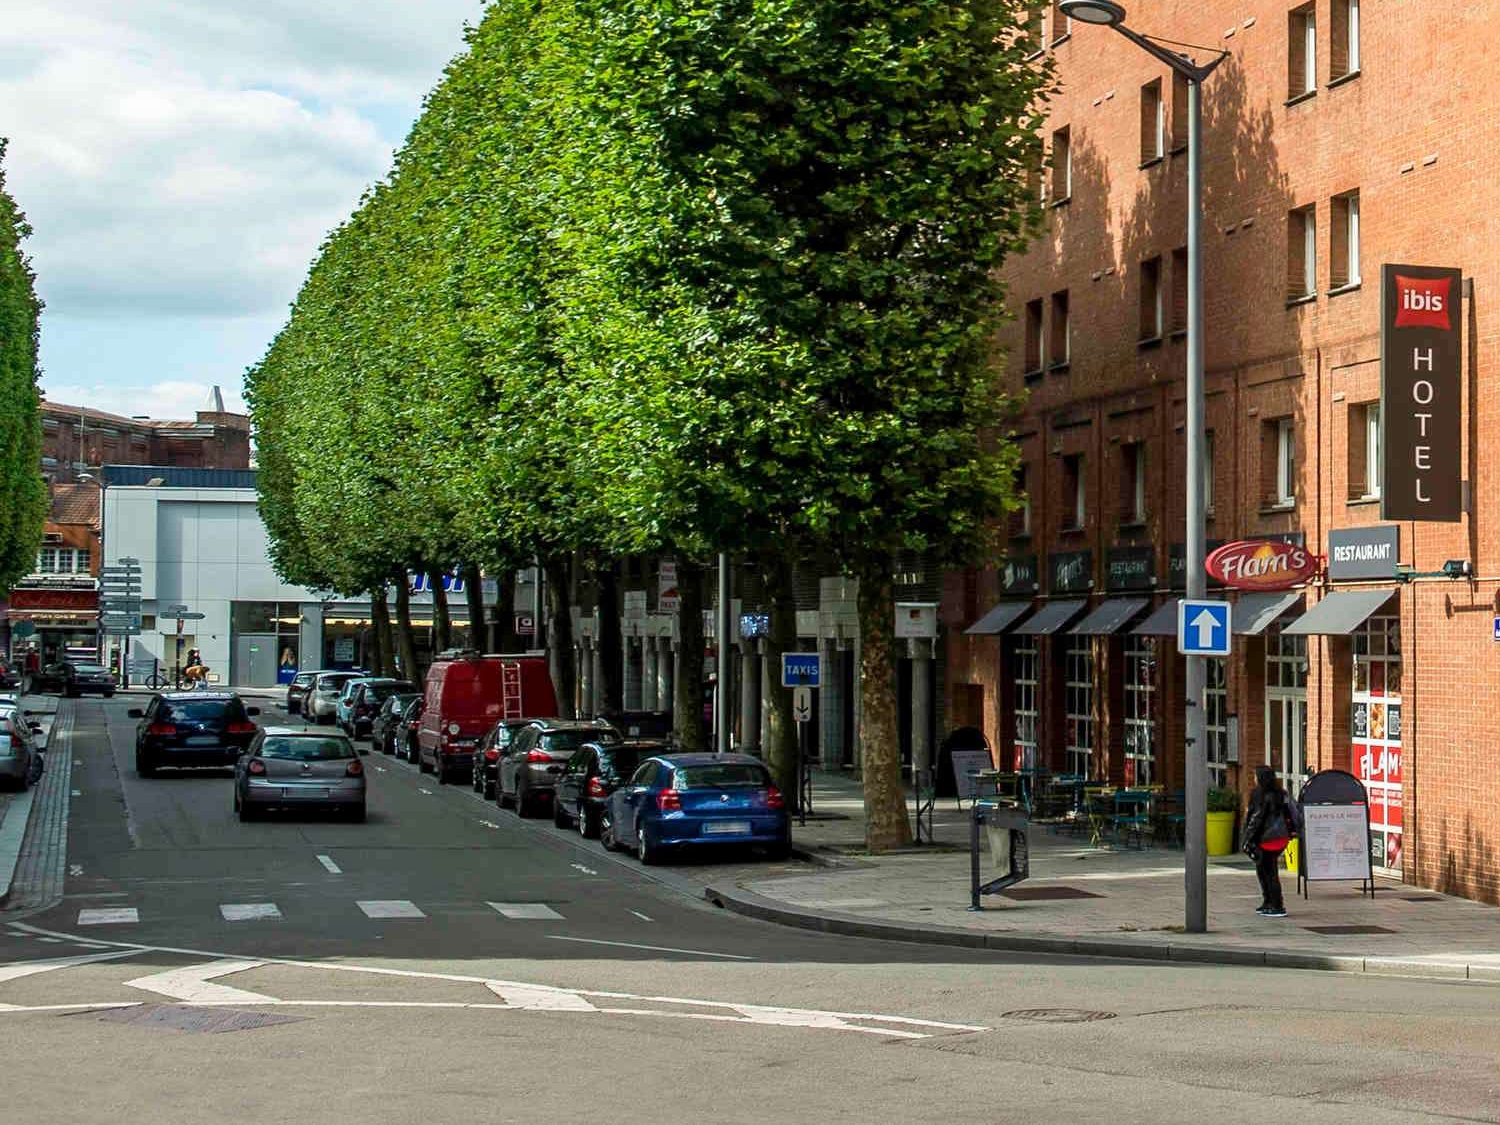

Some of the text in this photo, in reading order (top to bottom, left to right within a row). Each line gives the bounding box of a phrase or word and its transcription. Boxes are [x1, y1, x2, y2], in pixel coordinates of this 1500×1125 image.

[1403, 289, 1443, 312] ibis
[1412, 347, 1435, 503] HOTEL
[1222, 547, 1306, 580] Flam's
[1334, 543, 1392, 562] RESTAURANT
[786, 664, 818, 676] TAXIS
